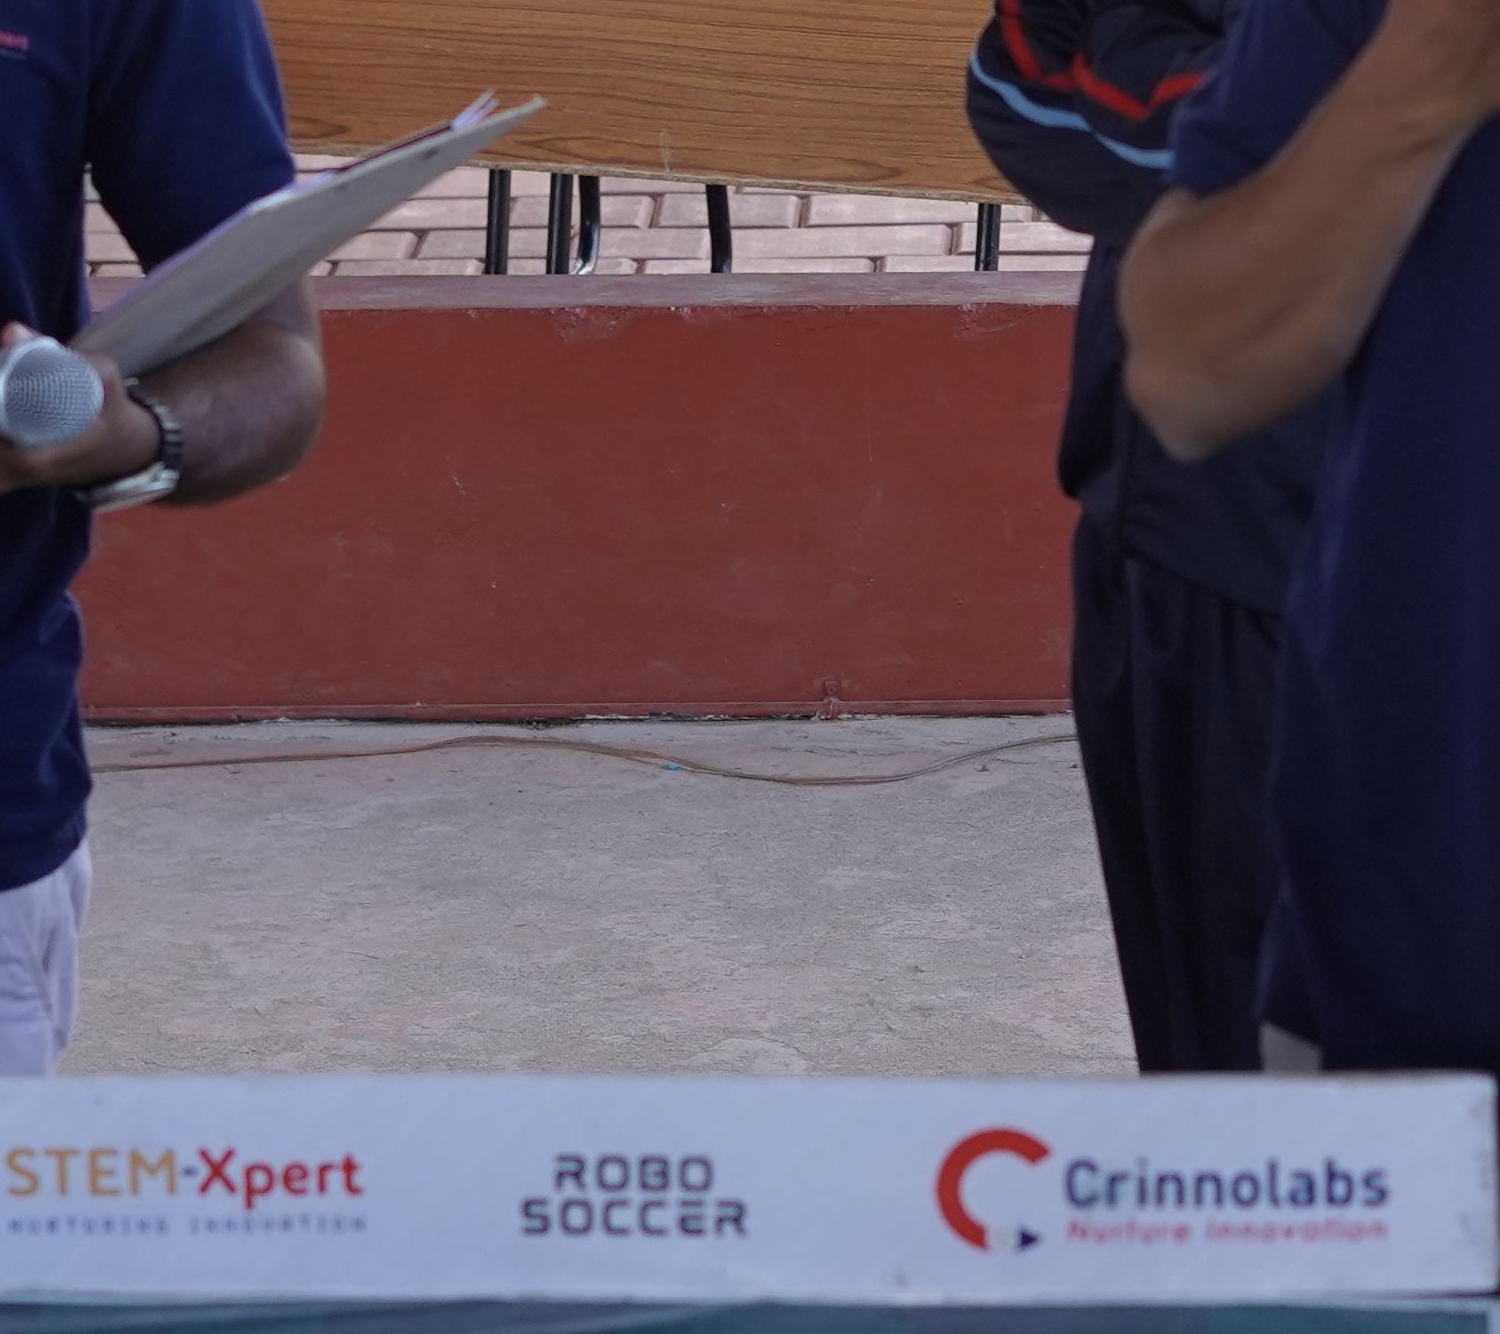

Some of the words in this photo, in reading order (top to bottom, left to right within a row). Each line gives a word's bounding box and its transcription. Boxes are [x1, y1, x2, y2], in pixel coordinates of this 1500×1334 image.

[5, 1147, 364, 1211] STEM-Xpert
[555, 1154, 713, 1193] ROBO
[1064, 1156, 1390, 1210] Crinnolabs
[521, 1198, 747, 1237] SOCCER
